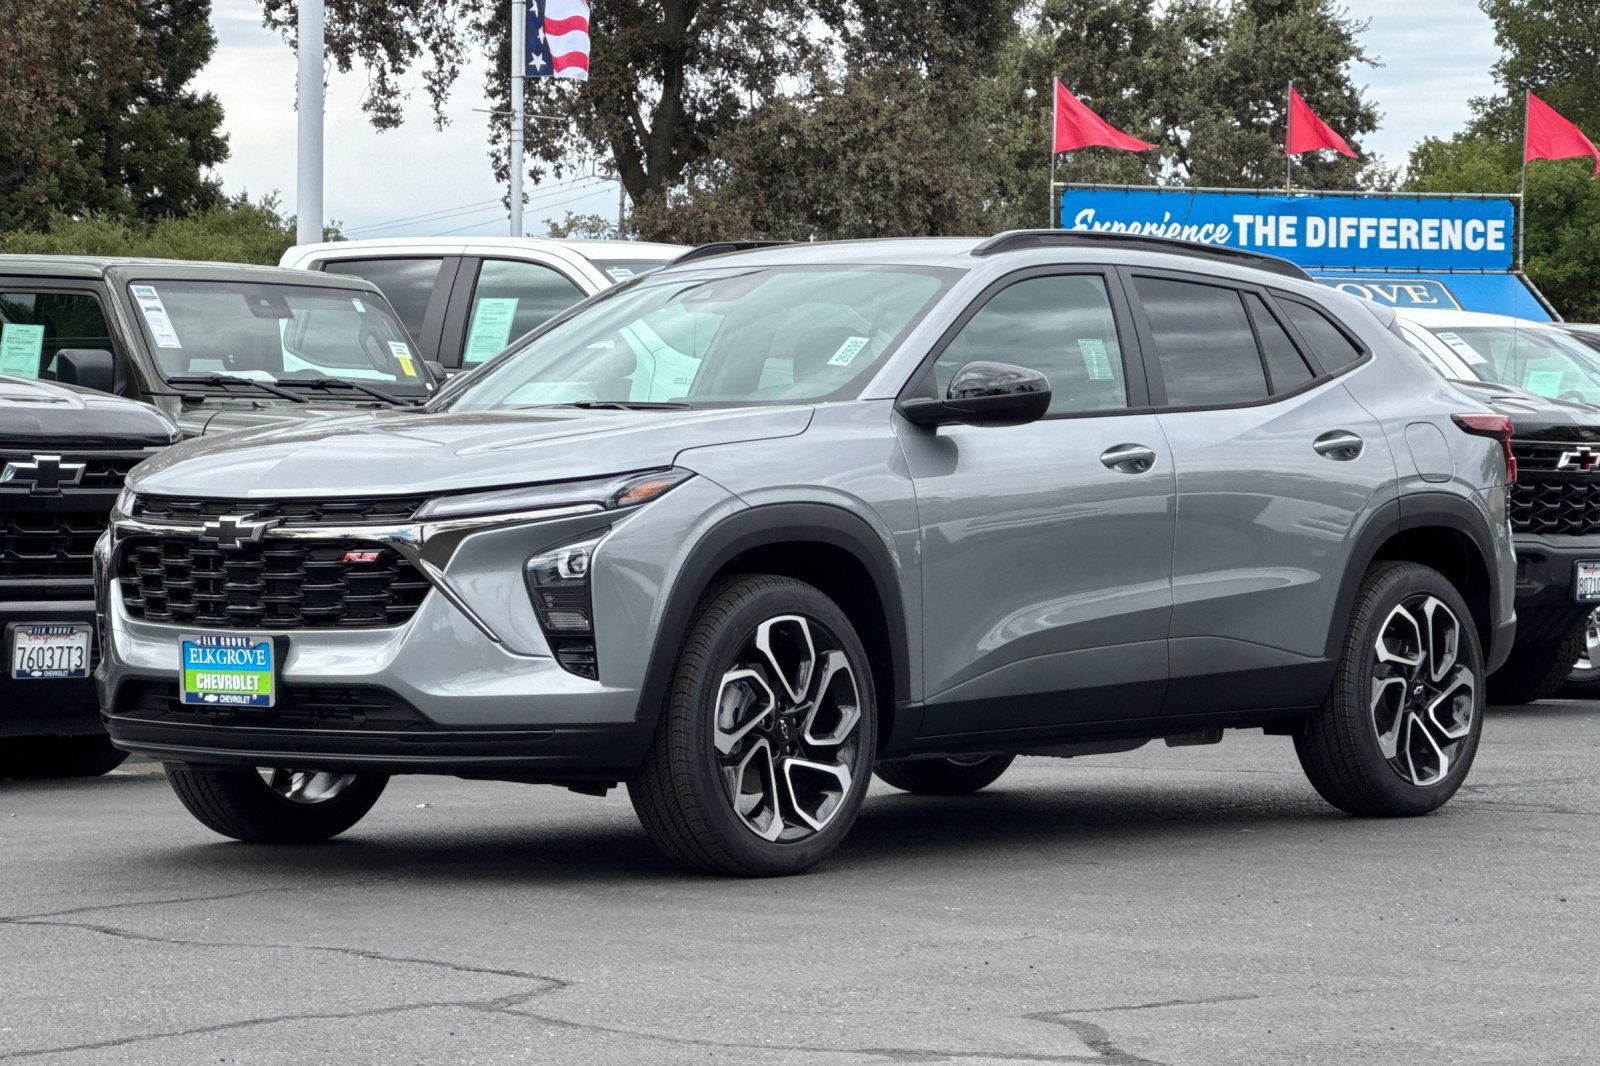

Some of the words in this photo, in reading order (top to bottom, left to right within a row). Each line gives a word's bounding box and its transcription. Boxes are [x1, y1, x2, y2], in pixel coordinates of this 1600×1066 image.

[1233, 214, 1298, 247] THE
[1306, 216, 1505, 251] DIFFERENCE
[343, 552, 379, 562] RS
[203, 636, 217, 646] ELK
[220, 636, 247, 647] GROVE
[17, 645, 84, 670] 76037T3
[196, 673, 260, 691] CHEVROLET
[219, 694, 251, 704] CHEVROLET
